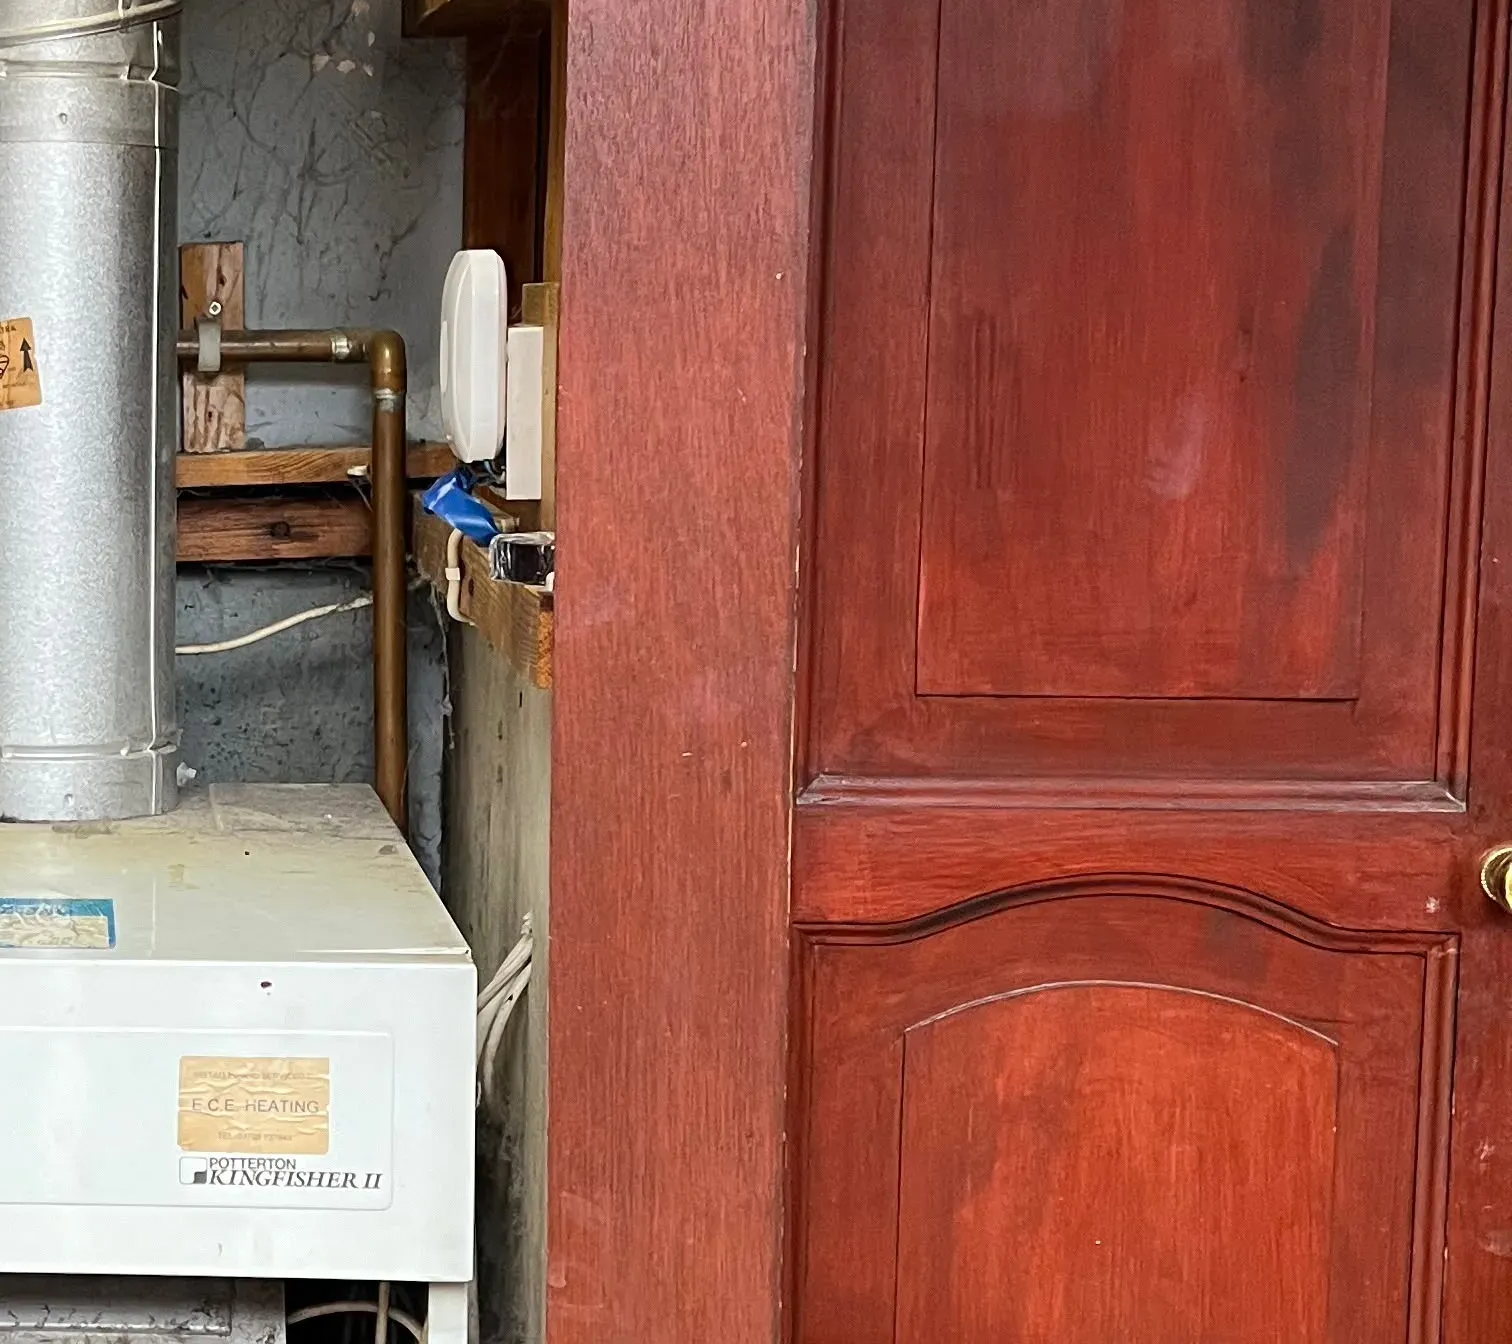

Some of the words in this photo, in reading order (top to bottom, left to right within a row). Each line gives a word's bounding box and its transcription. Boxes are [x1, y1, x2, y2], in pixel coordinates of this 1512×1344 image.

[245, 1099, 320, 1113] HEATING
[209, 1157, 297, 1170] POTTERTON
[209, 1169, 359, 1189] KINGFISHER
[361, 1172, 384, 1189] II
